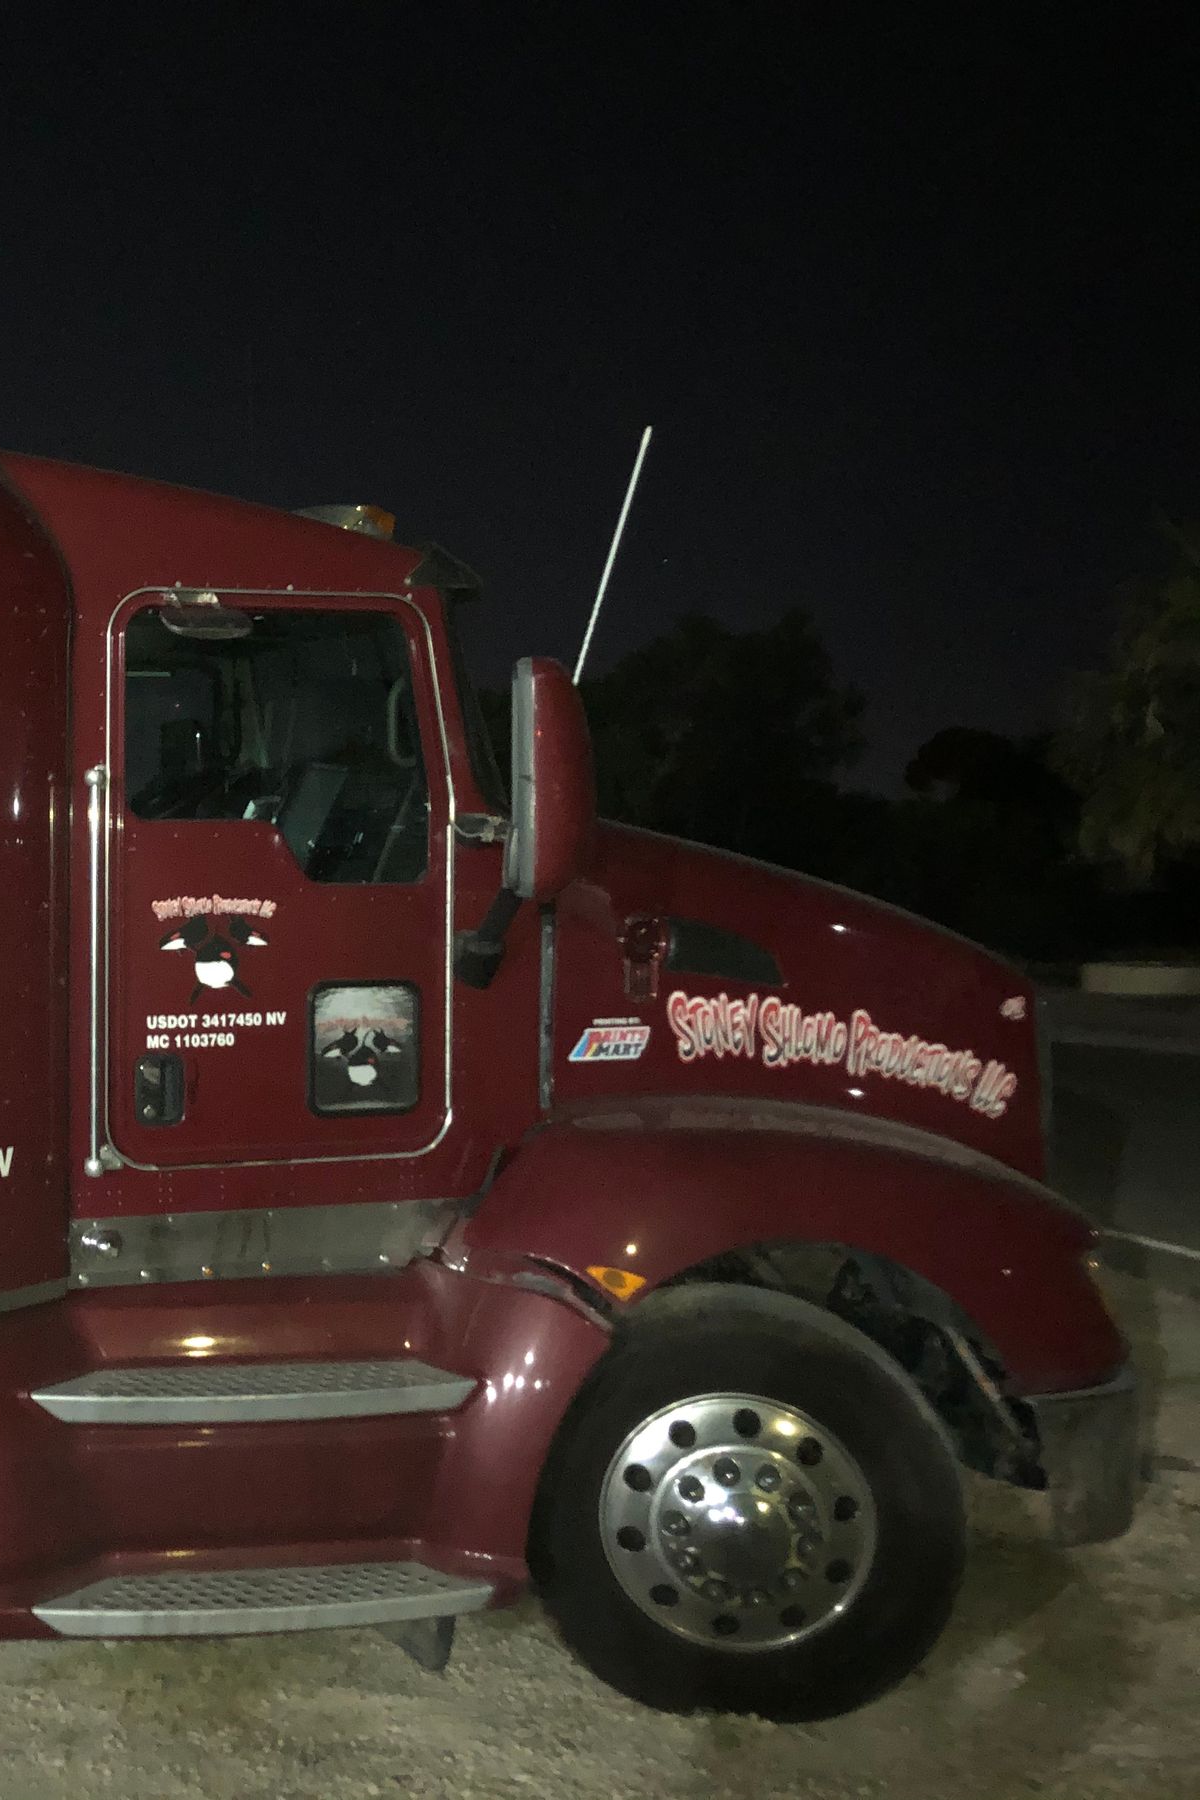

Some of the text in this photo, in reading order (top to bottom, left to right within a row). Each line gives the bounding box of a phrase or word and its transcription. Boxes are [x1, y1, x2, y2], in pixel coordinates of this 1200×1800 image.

[146, 1011, 286, 1030] USDOT 3417450 NV
[146, 1032, 235, 1049] MC 1103760
